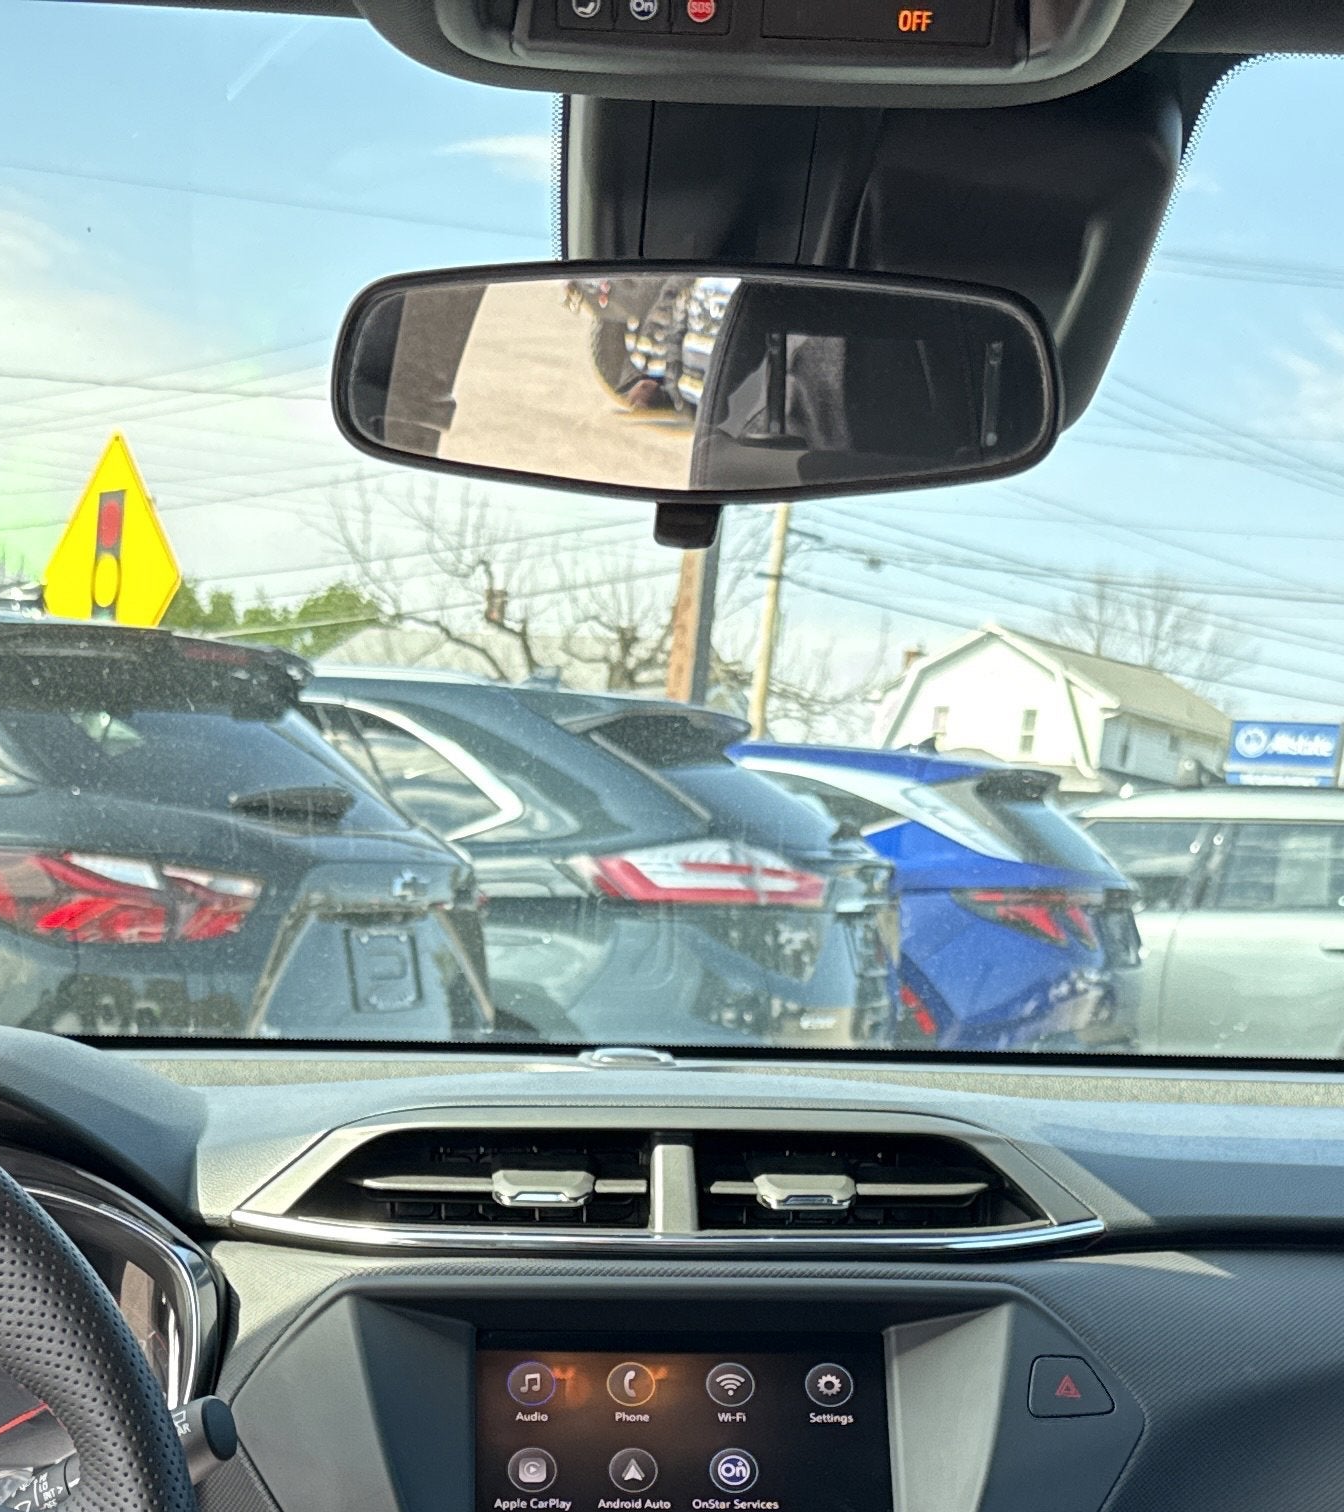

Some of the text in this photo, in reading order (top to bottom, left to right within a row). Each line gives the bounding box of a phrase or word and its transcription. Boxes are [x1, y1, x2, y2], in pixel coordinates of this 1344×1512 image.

[690, 0, 712, 13] SOS
[898, 9, 934, 33] OFF
[515, 1411, 549, 1422] Audio
[615, 1411, 650, 1423] Phone
[717, 1412, 747, 1423] Wi-Fi
[809, 1412, 854, 1426] Settings
[493, 1498, 572, 1511] Apple CarPlay
[597, 1498, 671, 1510] Android Auto
[692, 1498, 780, 1510] OnStar Services
